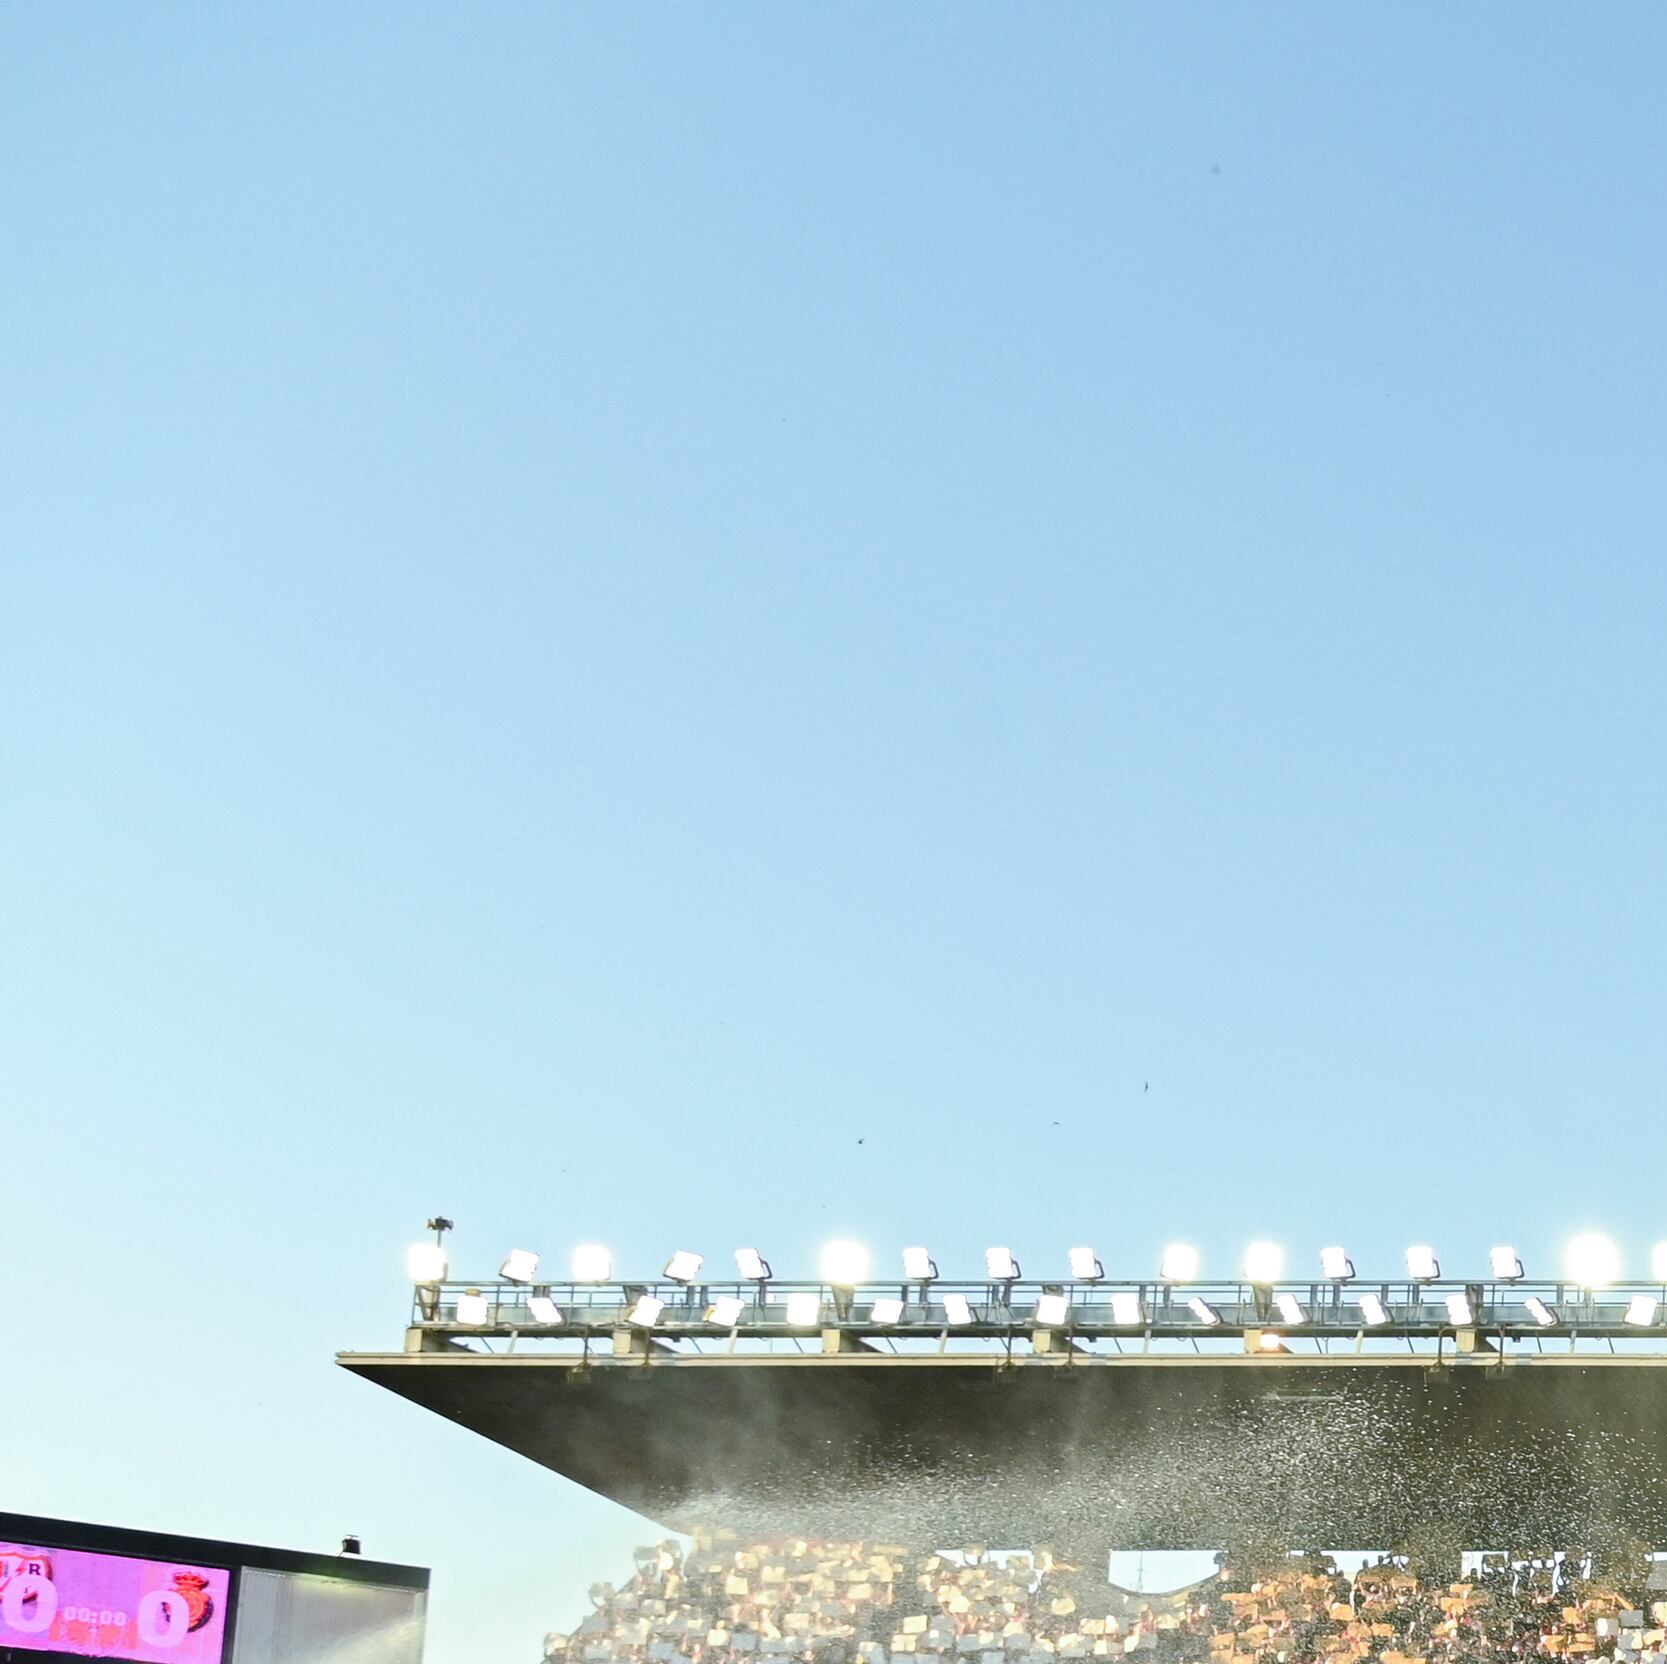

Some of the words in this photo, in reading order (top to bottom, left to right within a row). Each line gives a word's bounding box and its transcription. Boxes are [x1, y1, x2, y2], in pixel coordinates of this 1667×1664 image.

[3, 1573, 58, 1633] 0
[63, 1606, 127, 1626] 00:00
[138, 1589, 190, 1648] 0
